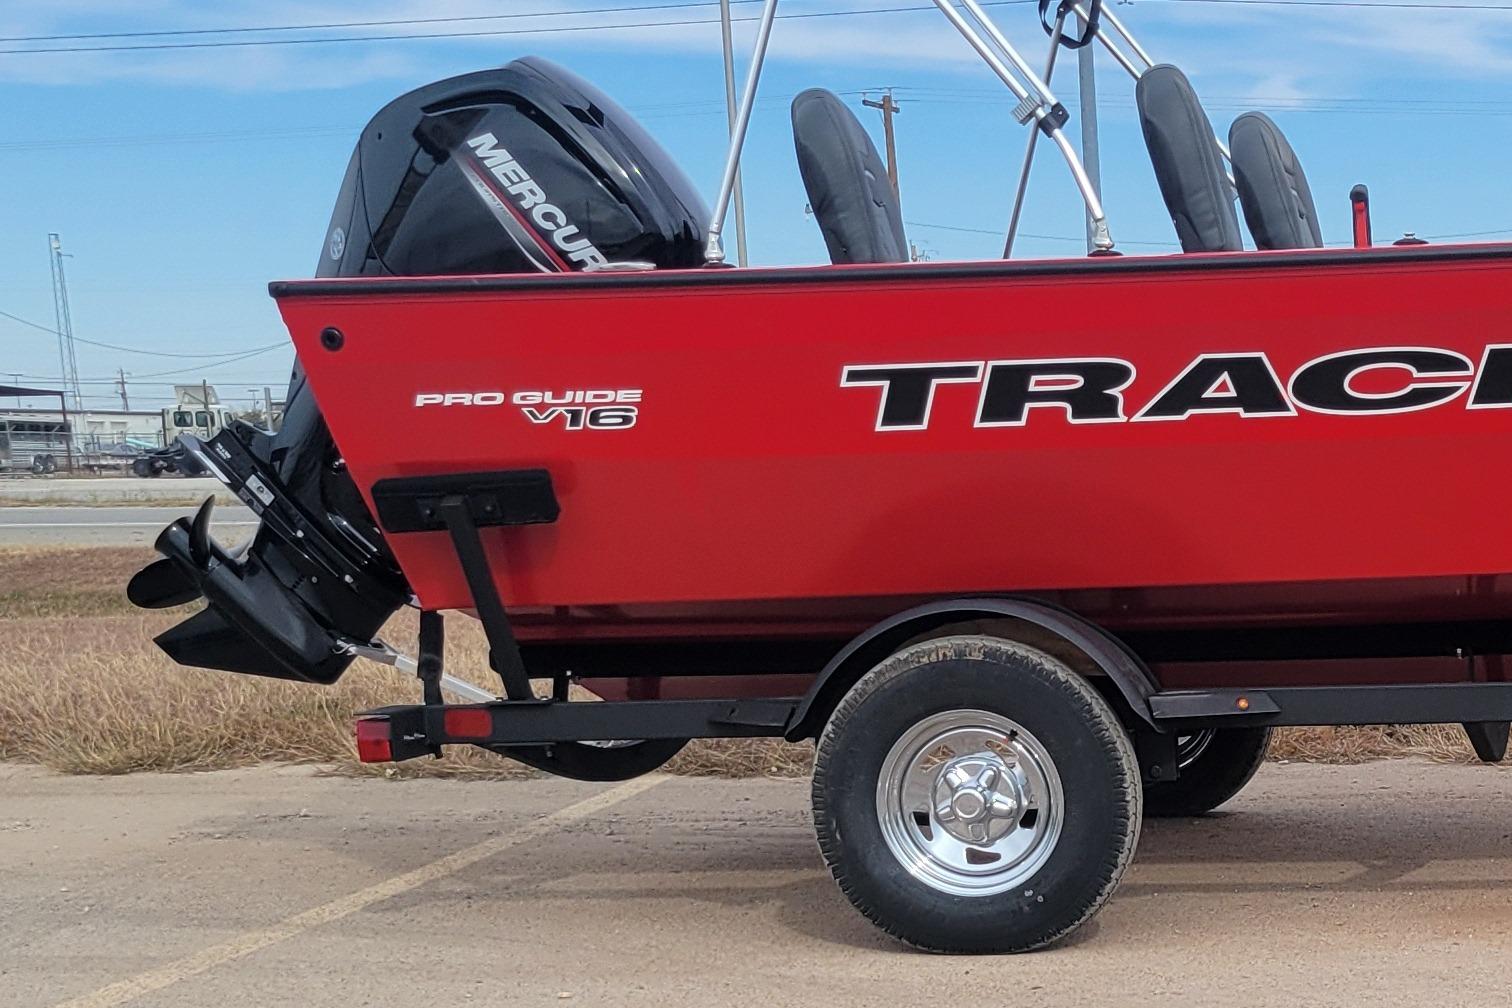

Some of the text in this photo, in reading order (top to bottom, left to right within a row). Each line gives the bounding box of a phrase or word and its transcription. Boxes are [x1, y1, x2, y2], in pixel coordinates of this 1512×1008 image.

[467, 132, 609, 273] MERCUR
[415, 389, 643, 407] PRO GUIDE
[521, 405, 639, 431] V16
